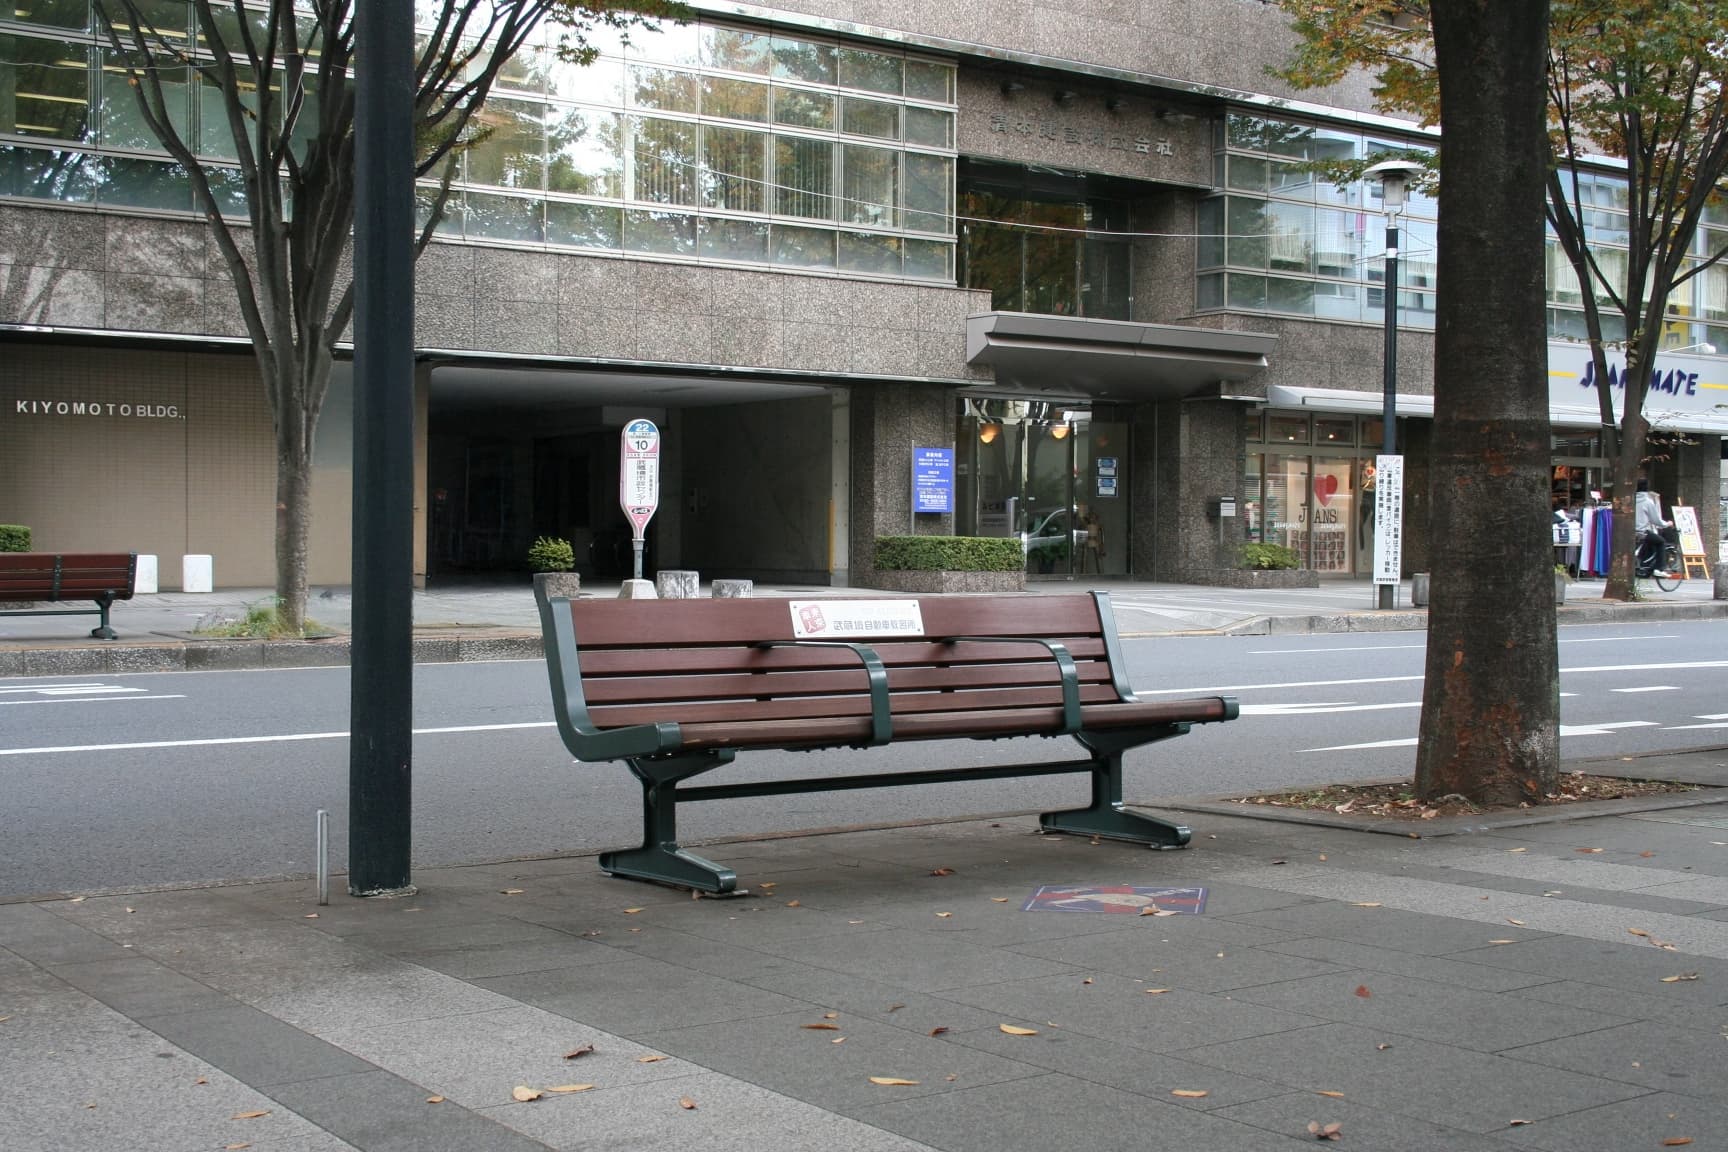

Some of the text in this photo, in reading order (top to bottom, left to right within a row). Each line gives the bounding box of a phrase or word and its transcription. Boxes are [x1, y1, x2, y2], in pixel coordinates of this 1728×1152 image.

[16, 400, 132, 416] KIYOMOTO
[635, 423, 650, 432] 22
[635, 440, 648, 451] 10
[1298, 507, 1338, 524] JANS
